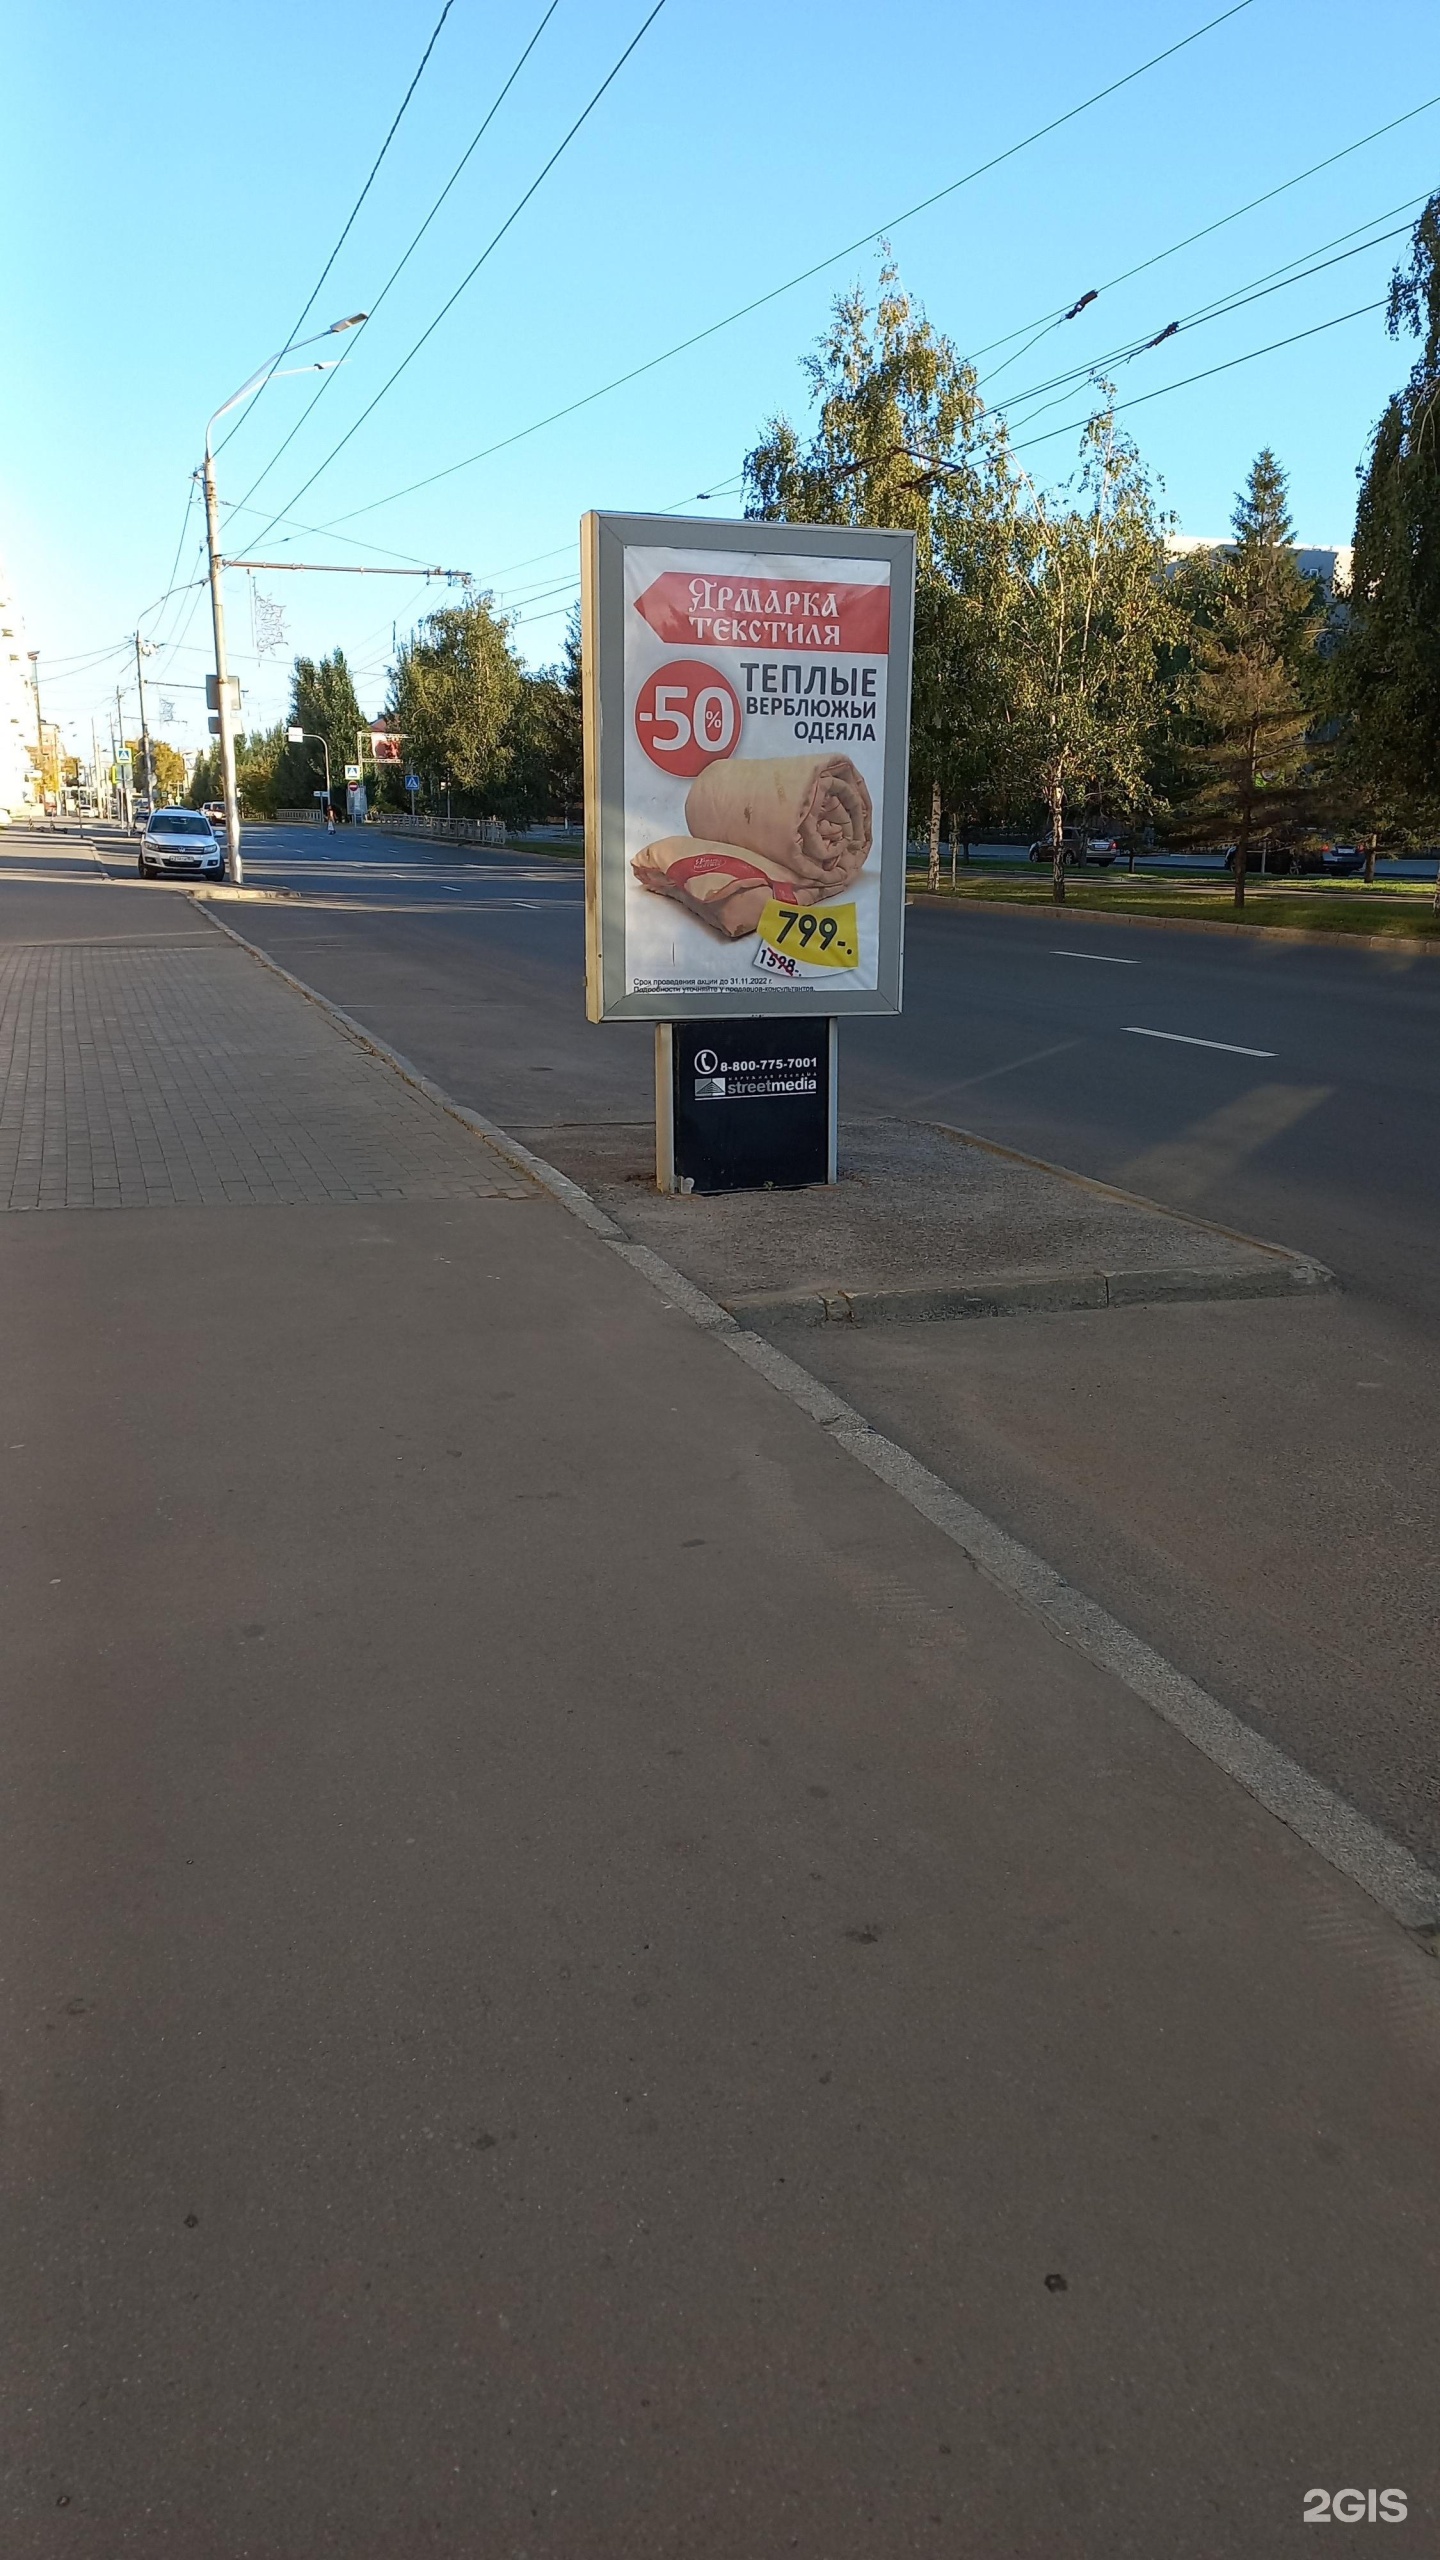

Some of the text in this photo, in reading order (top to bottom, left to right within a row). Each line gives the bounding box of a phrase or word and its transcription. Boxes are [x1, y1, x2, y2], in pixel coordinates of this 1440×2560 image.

[688, 616, 841, 646] ТЕКСТИЛЯ
[740, 662, 877, 697] ТЕПЛЫЕ
[746, 696, 877, 719] ВЕРБЛЮЖЬИ
[794, 721, 876, 744] ОДЕЯЛА
[633, 978, 651, 986] Срок
[730, 977, 767, 985] 31.11.2022
[720, 1057, 817, 1072] 8-800-775-7001
[728, 1077, 817, 1094] streetmedia
